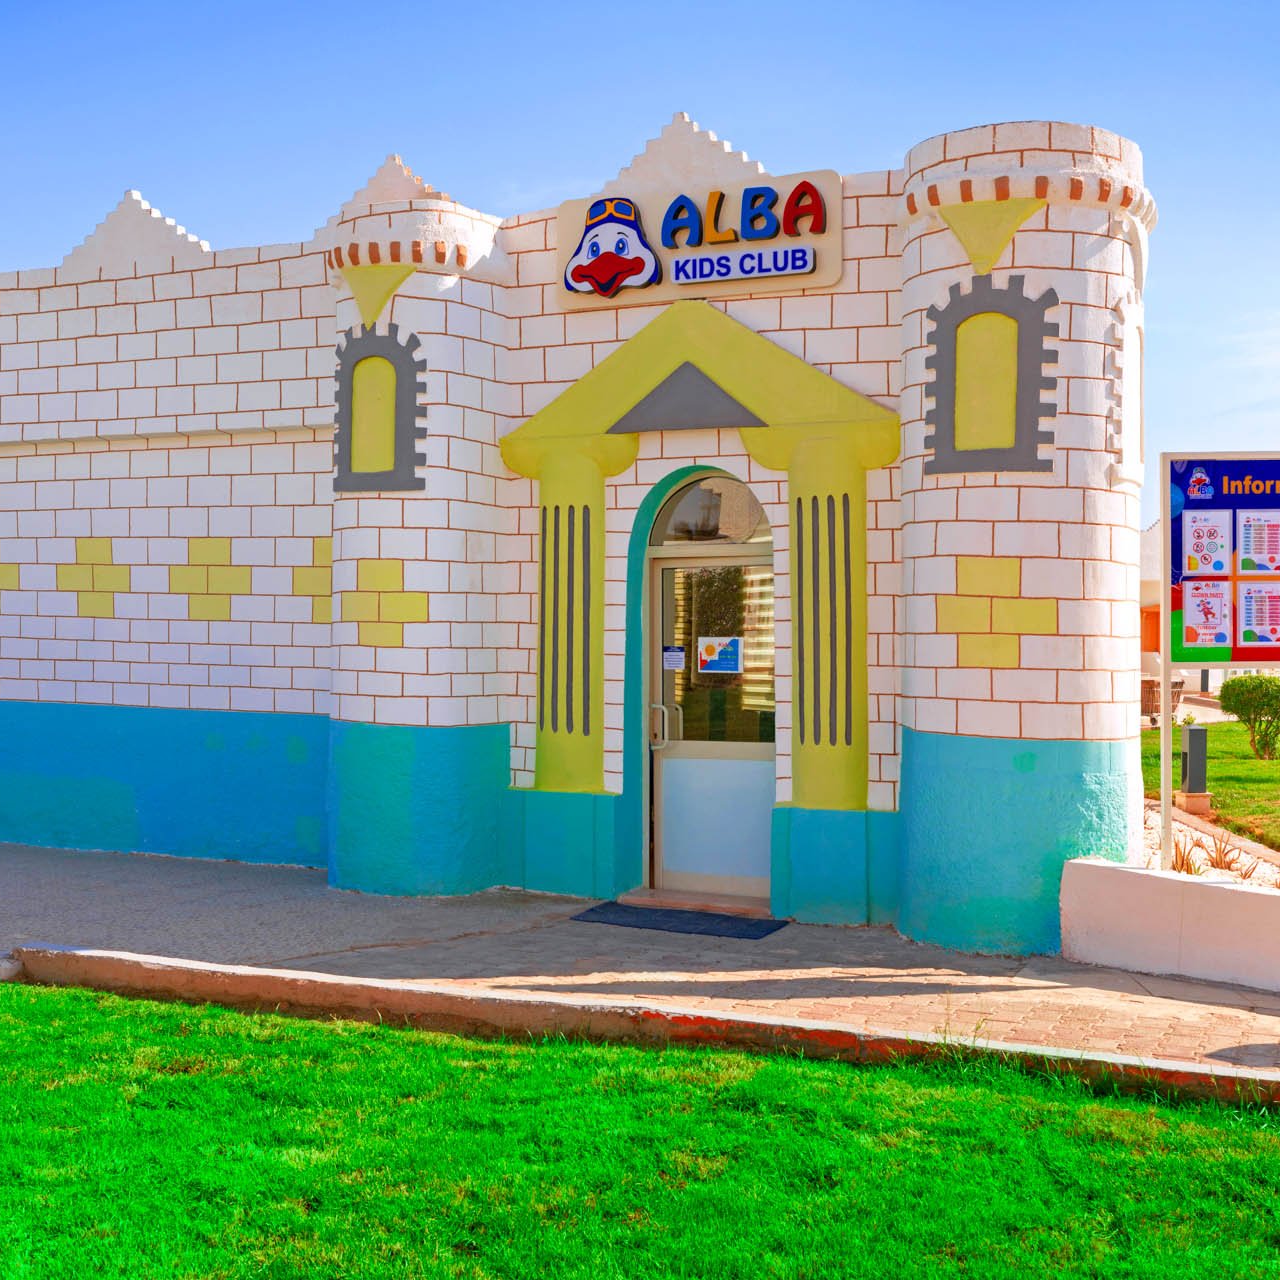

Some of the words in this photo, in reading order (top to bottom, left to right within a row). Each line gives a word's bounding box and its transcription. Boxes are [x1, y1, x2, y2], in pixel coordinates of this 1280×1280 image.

[660, 180, 827, 250] ALBA
[674, 256, 732, 281] KIDS
[738, 248, 808, 274] CLUB
